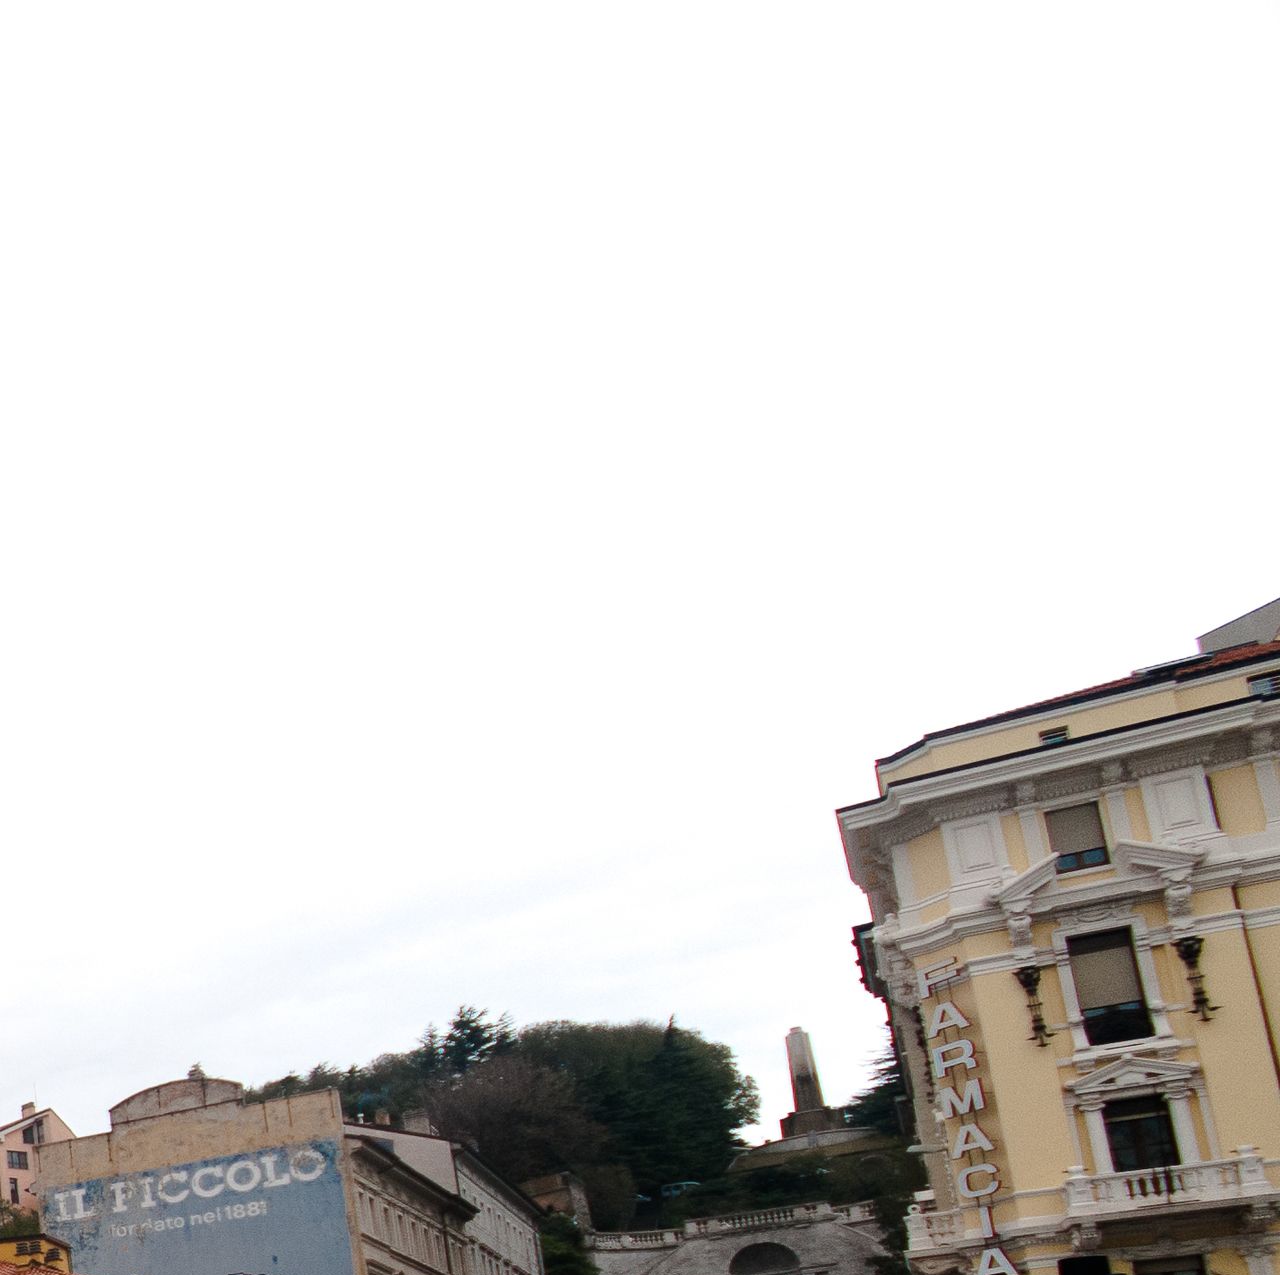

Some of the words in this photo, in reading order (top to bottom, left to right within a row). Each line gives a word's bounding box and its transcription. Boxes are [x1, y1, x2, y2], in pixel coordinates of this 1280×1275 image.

[53, 1188, 97, 1222] IL
[109, 1149, 327, 1213] PICCOLO
[190, 1206, 221, 1226] nel
